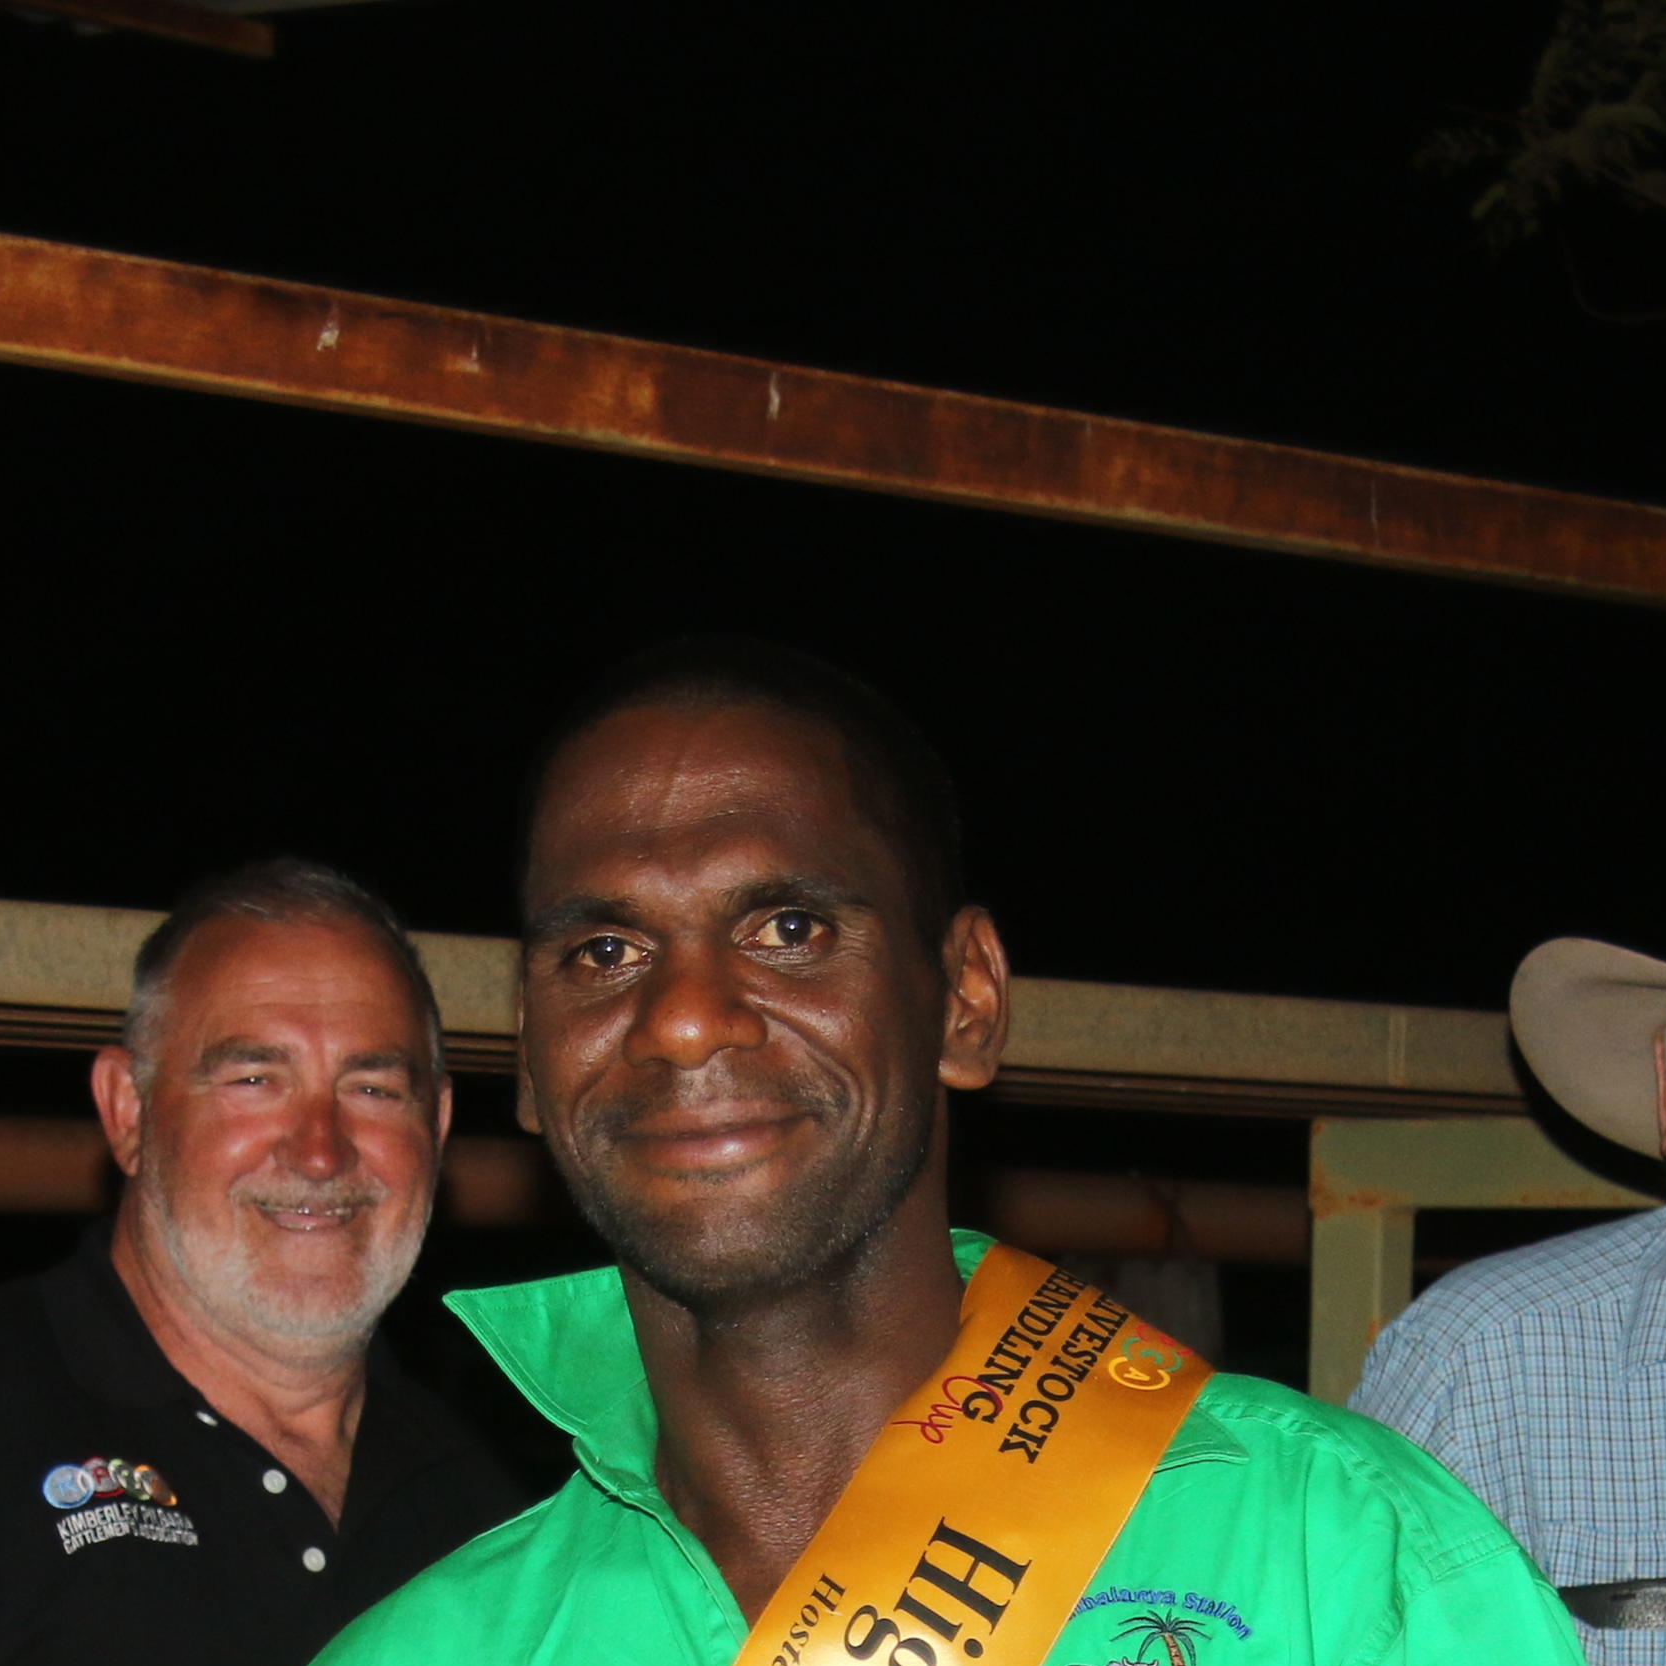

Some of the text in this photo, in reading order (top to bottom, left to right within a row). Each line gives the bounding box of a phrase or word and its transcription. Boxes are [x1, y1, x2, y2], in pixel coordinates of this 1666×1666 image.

[961, 1267, 1089, 1424] HANDLING
[891, 1375, 1004, 1444] Cup
[1184, 1591, 1251, 1641] Station
